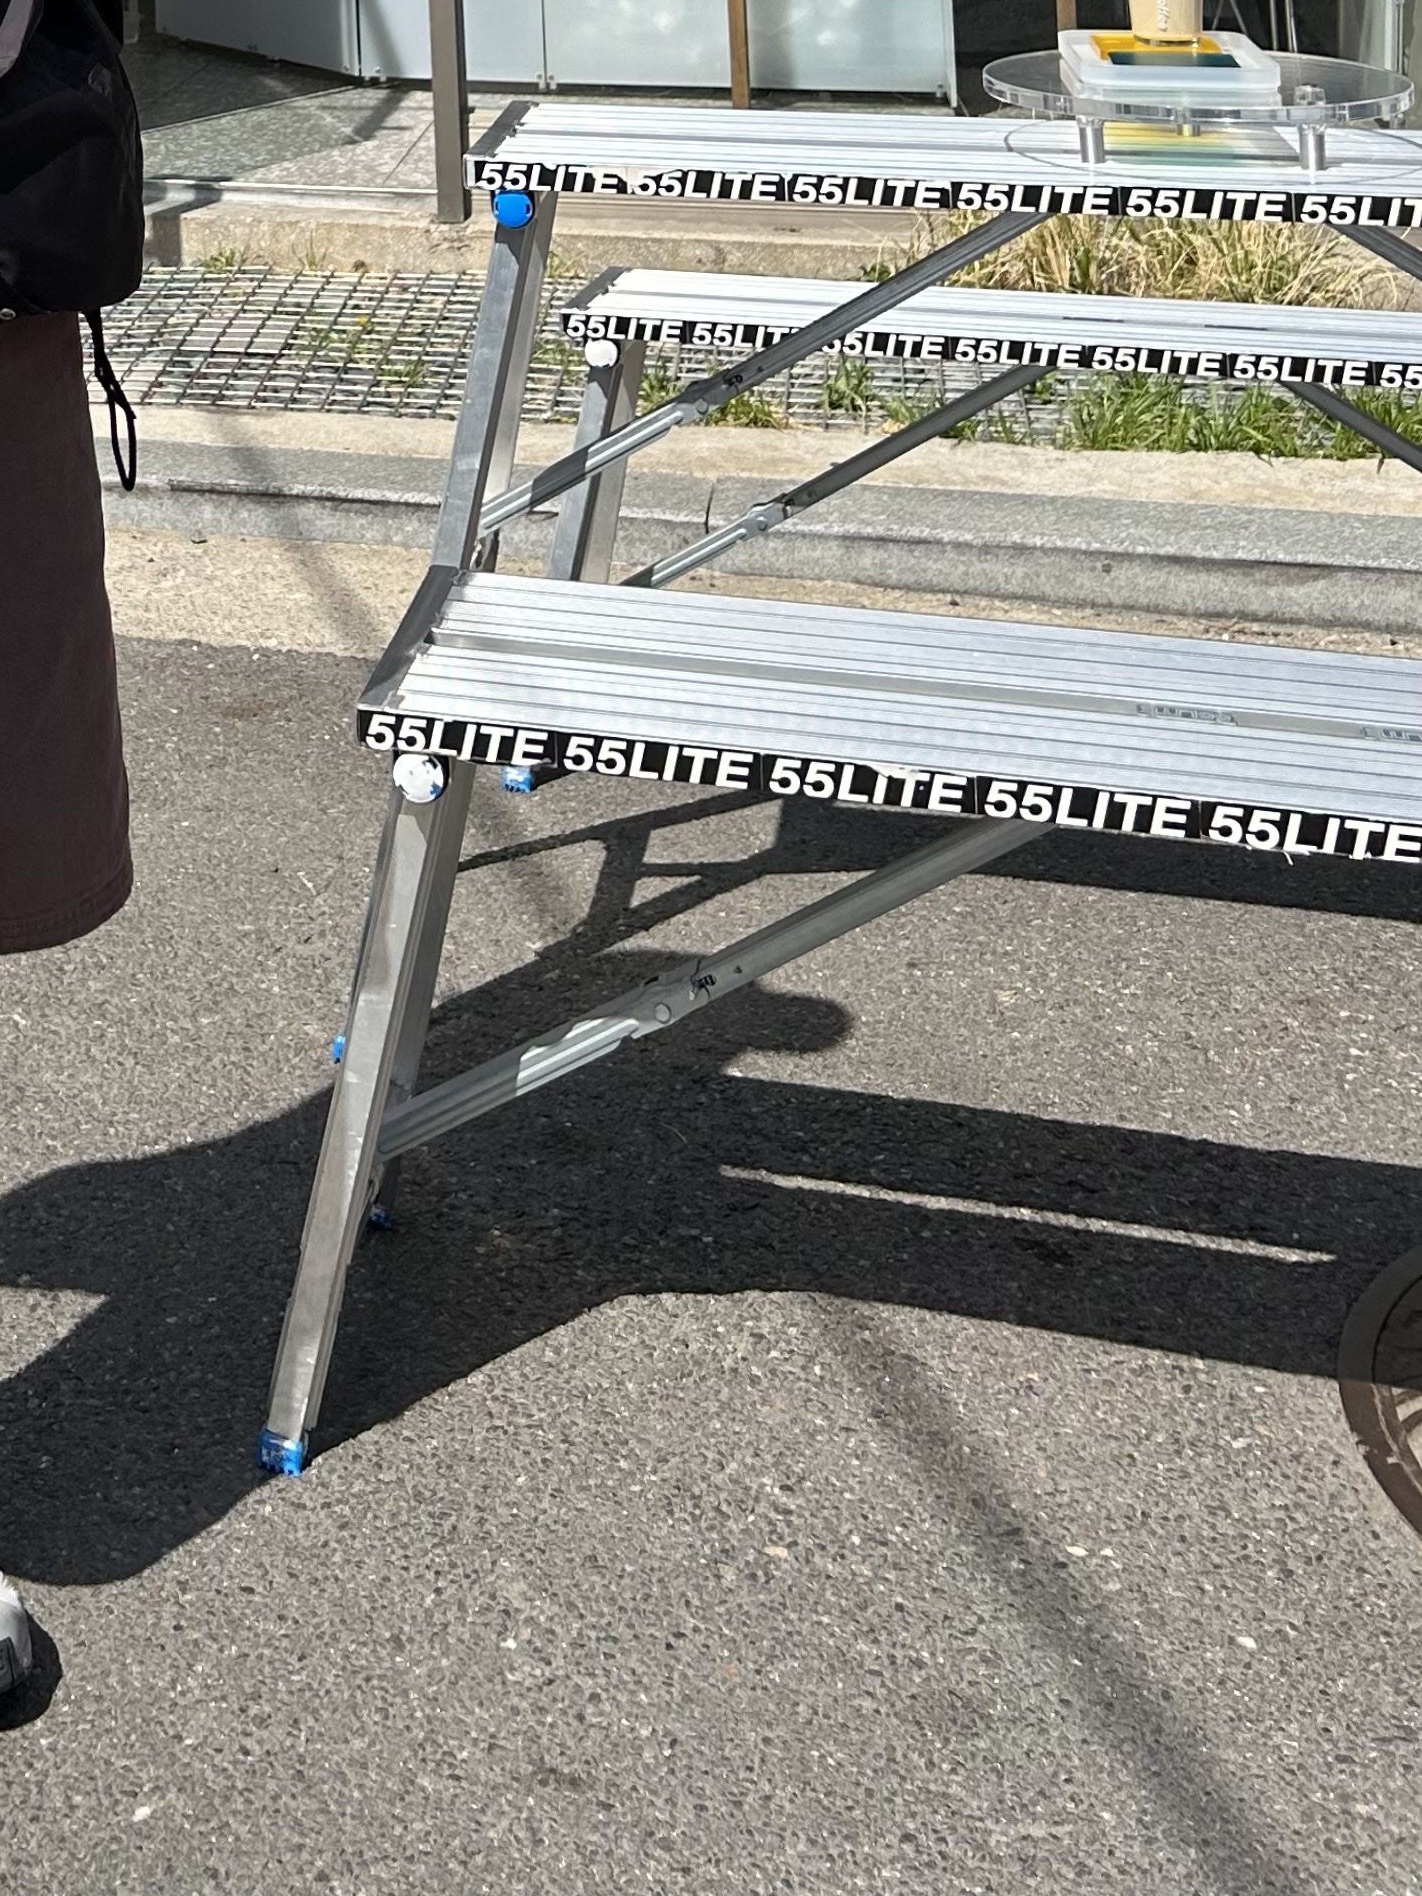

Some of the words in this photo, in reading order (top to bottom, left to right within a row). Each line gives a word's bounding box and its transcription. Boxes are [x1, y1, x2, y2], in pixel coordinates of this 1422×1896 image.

[478, 162, 620, 195] 55LITE
[632, 169, 780, 202] 55LITE
[792, 176, 942, 209] 55LITE
[958, 183, 1114, 216] 55LITE
[1126, 188, 1288, 222] 55LITE
[566, 314, 684, 343] 55LITE
[692, 321, 801, 348] 55LIT
[955, 339, 1082, 369] 55LITE
[1092, 347, 1224, 377] 55LITE
[1233, 353, 1370, 386] 55LITE
[366, 714, 551, 767] 55LITE
[563, 736, 754, 790] 55LITE
[769, 758, 968, 814] 55LITE
[984, 782, 1192, 838] 55LITE
[1208, 806, 1422, 863] 55LITE
